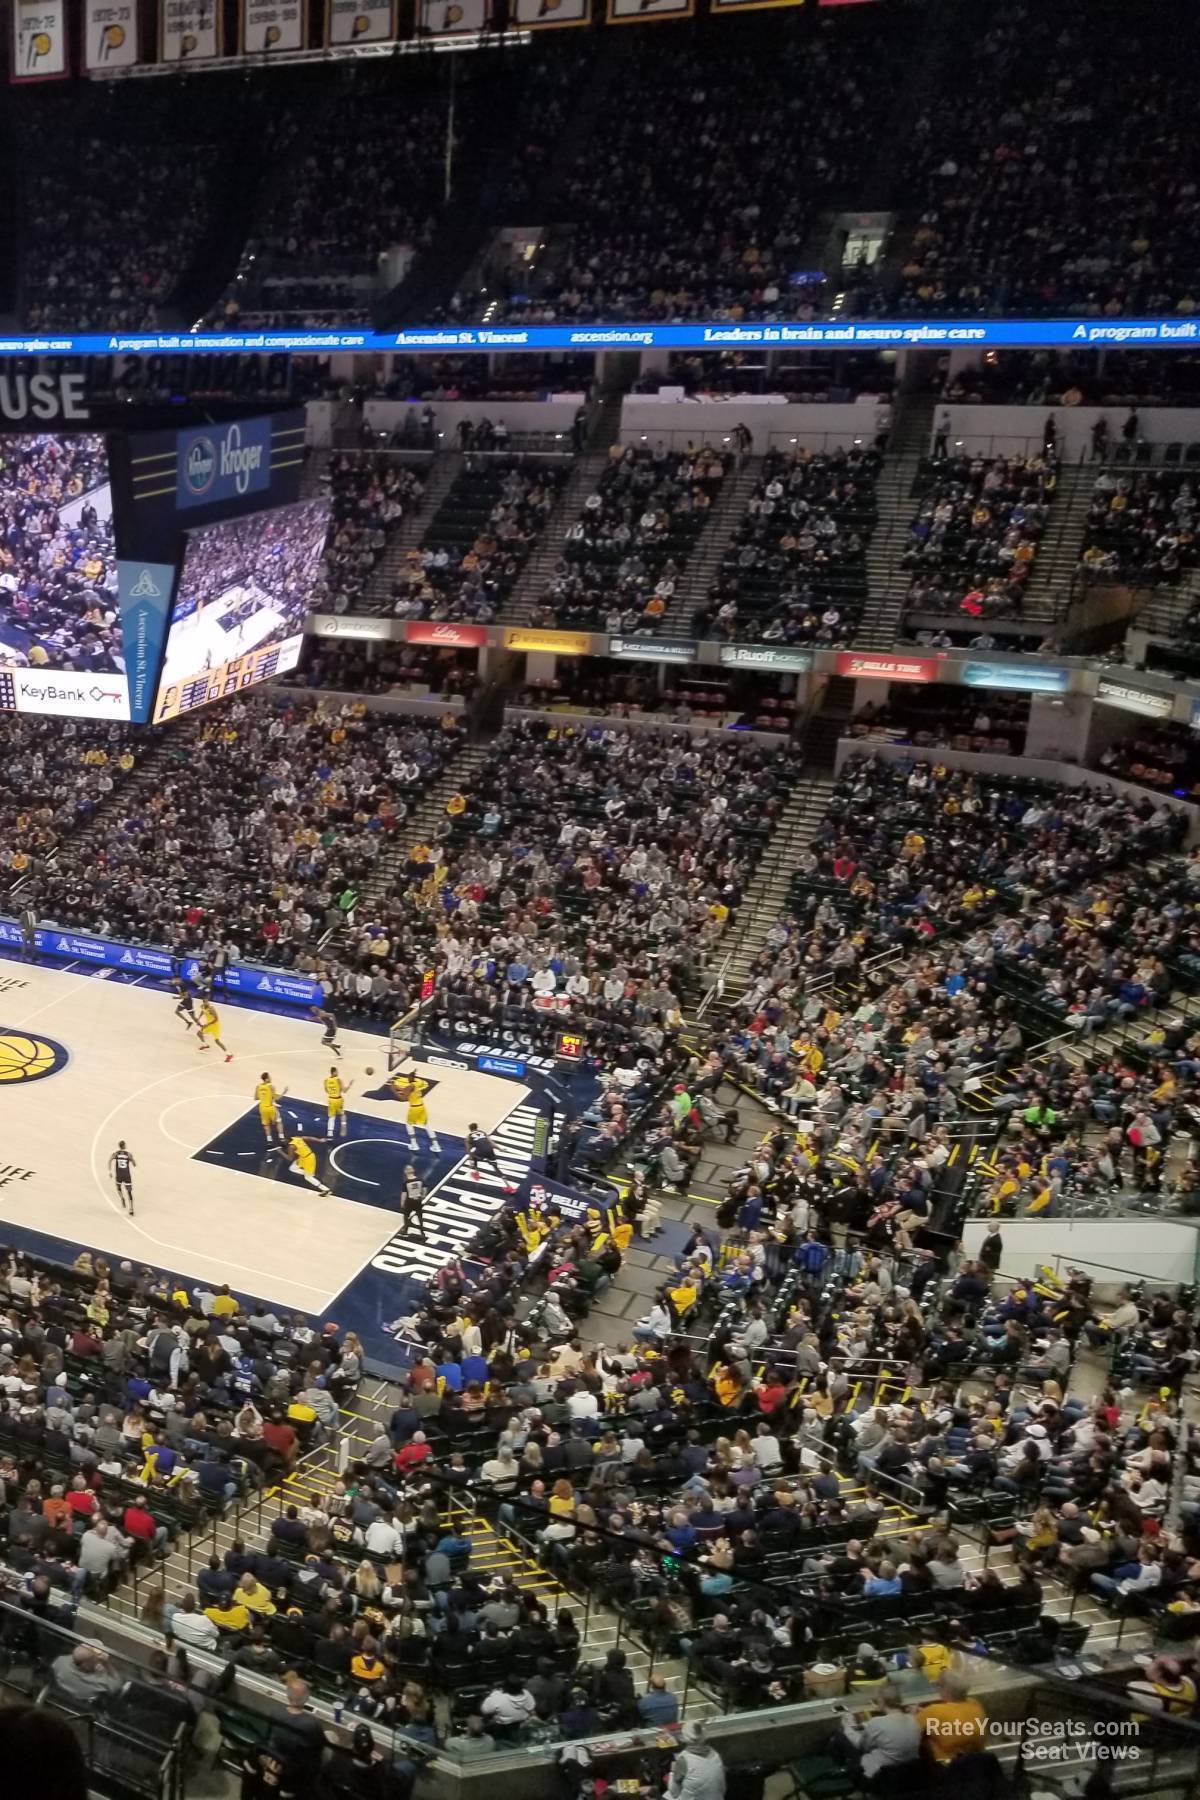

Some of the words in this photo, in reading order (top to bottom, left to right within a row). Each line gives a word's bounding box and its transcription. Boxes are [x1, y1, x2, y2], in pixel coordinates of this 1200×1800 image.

[396, 333, 457, 344] Ascension
[458, 333, 477, 343] St.
[478, 332, 527, 344] Vincent
[570, 330, 653, 344] ascension.org
[704, 328, 762, 341] Leaders
[763, 327, 780, 340] in
[781, 327, 823, 340] brain
[824, 326, 855, 340] and
[856, 329, 902, 340] neuro
[903, 326, 948, 342] spine
[949, 329, 986, 339] care
[1072, 325, 1087, 338] A
[1089, 326, 1157, 341] program
[1160, 323, 1196, 338] built
[119, 339, 158, 351] program
[159, 337, 180, 348] built
[195, 337, 244, 347] innovation
[245, 336, 264, 346] and
[264, 335, 341, 348] compassionate
[343, 337, 364, 345] care
[220, 424, 263, 494] Kroger
[738, 649, 776, 663] Ruoff
[20, 683, 85, 702] KeyBank
[135, 673, 147, 709] Vincent
[503, 1031, 514, 1042] G
[519, 1034, 532, 1045] G
[426, 1055, 469, 1071] GEICO
[456, 1042, 558, 1069] @PACERS
[551, 1194, 589, 1211] BELLE
[559, 1205, 582, 1219] TIRE
